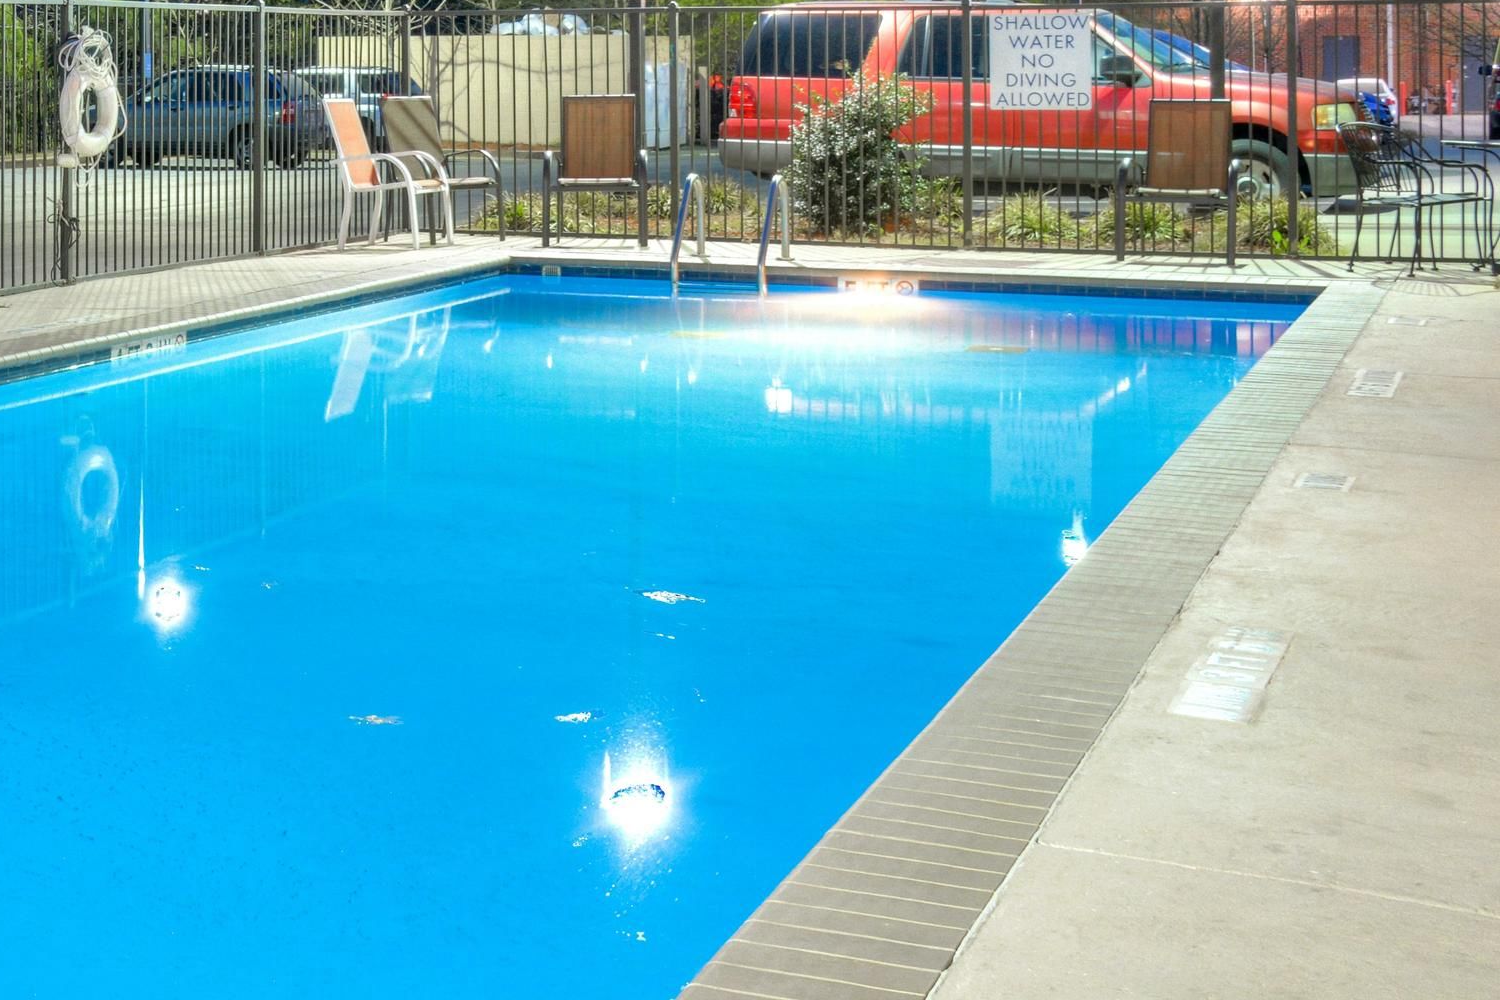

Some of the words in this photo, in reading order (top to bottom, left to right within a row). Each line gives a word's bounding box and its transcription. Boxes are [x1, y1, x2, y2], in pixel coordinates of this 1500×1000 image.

[993, 15, 1089, 31] SHALLOW
[1008, 34, 1075, 49] WATER
[1021, 53, 1054, 68] NO
[1006, 72, 1077, 88] DIVING
[995, 91, 1090, 107] ALLOWED
